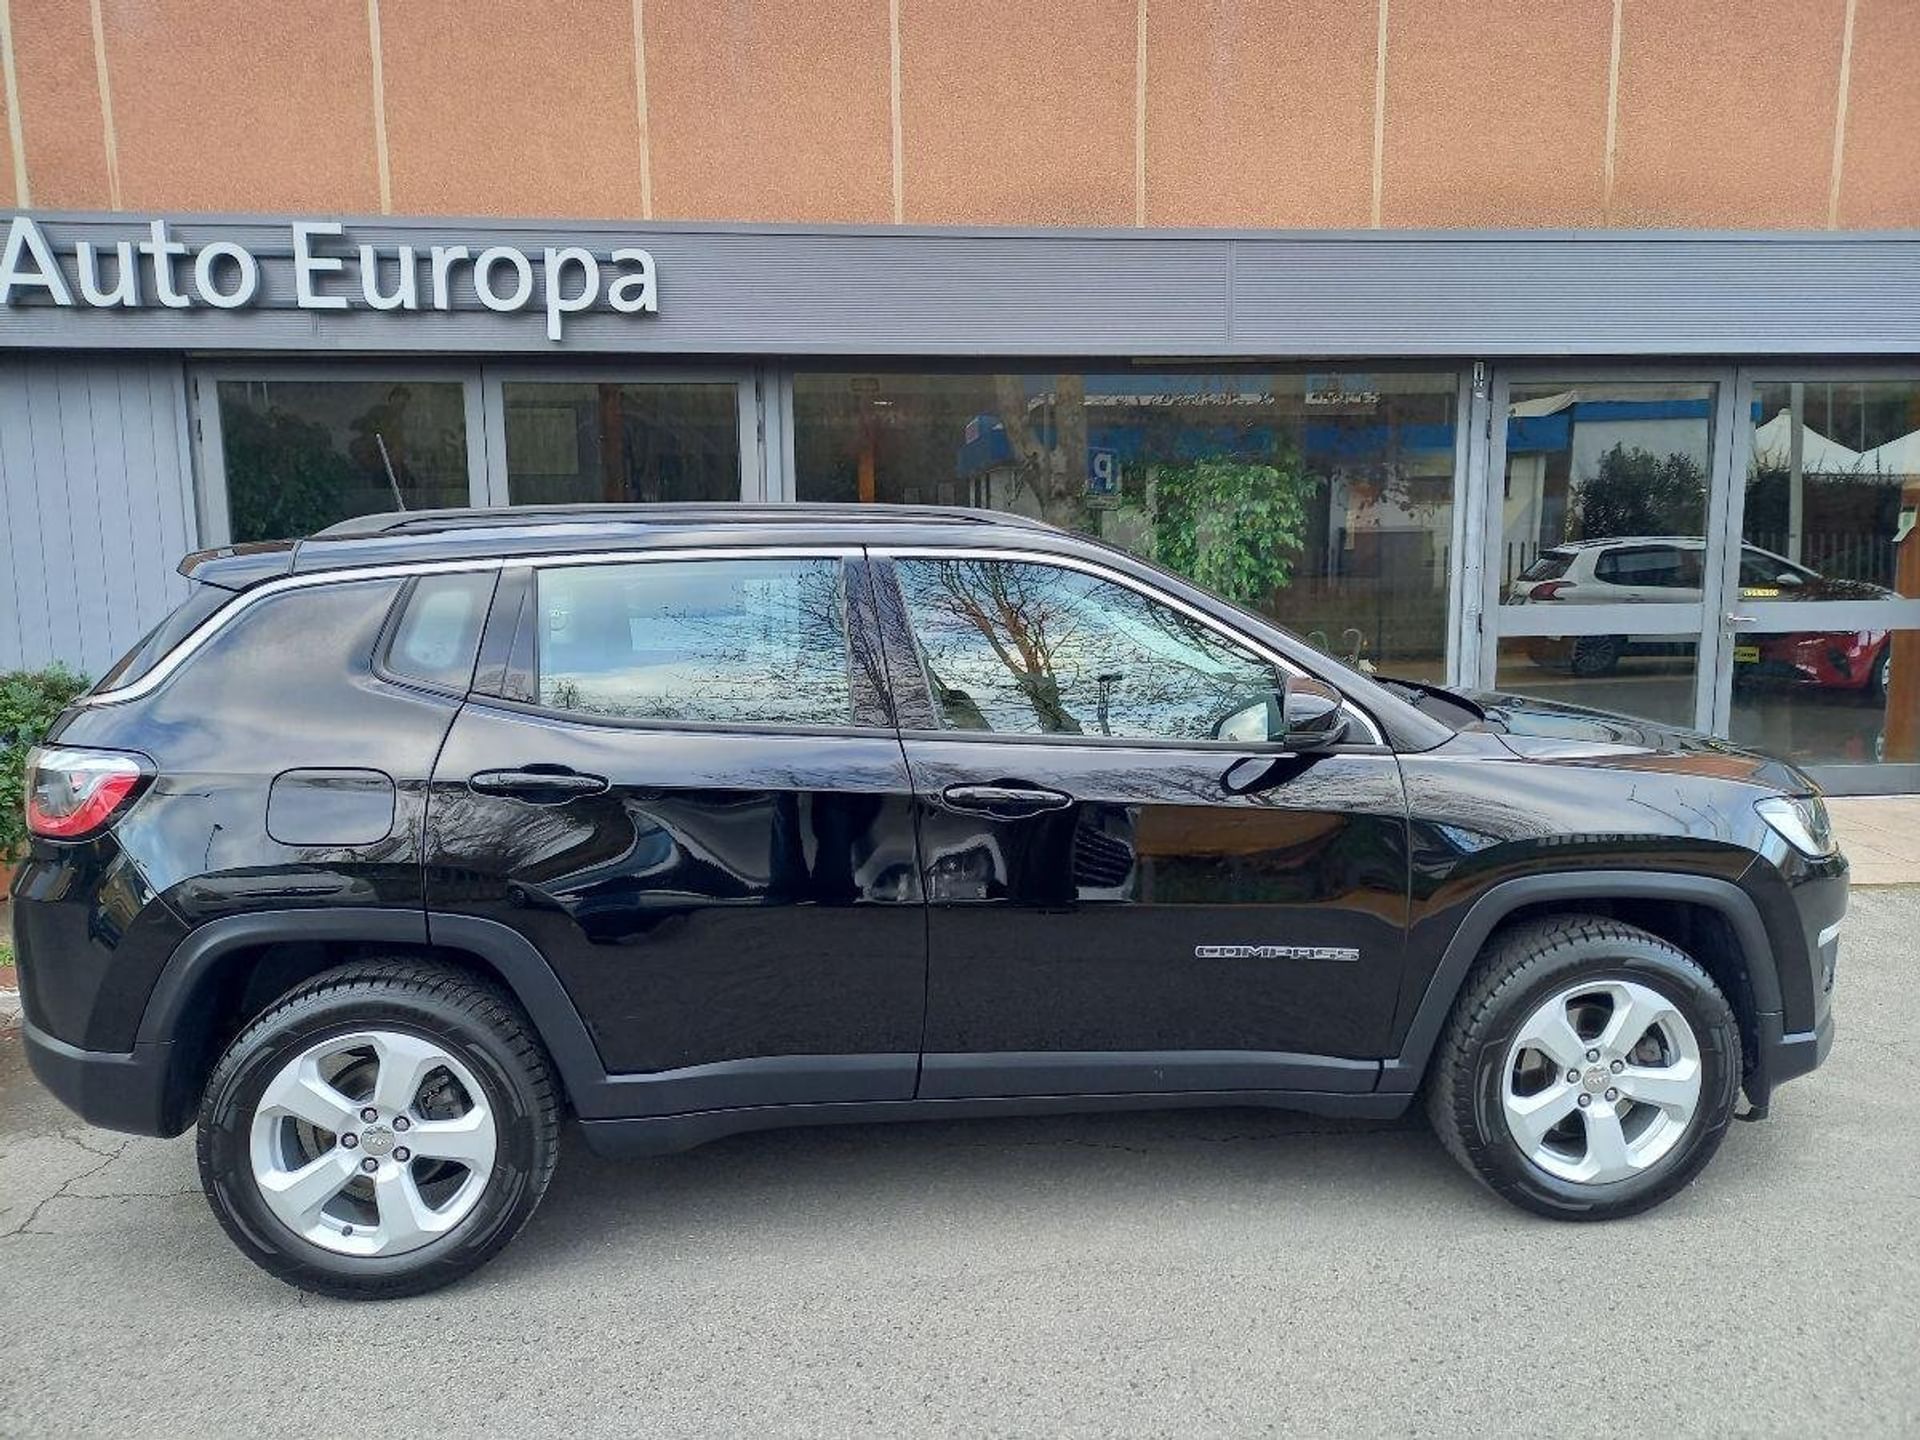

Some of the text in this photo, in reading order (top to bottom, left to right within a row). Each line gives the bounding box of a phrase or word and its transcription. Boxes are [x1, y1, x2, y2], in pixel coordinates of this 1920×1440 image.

[0, 216, 659, 341] Auto Europa
[1195, 945, 1360, 961] COMPASS
